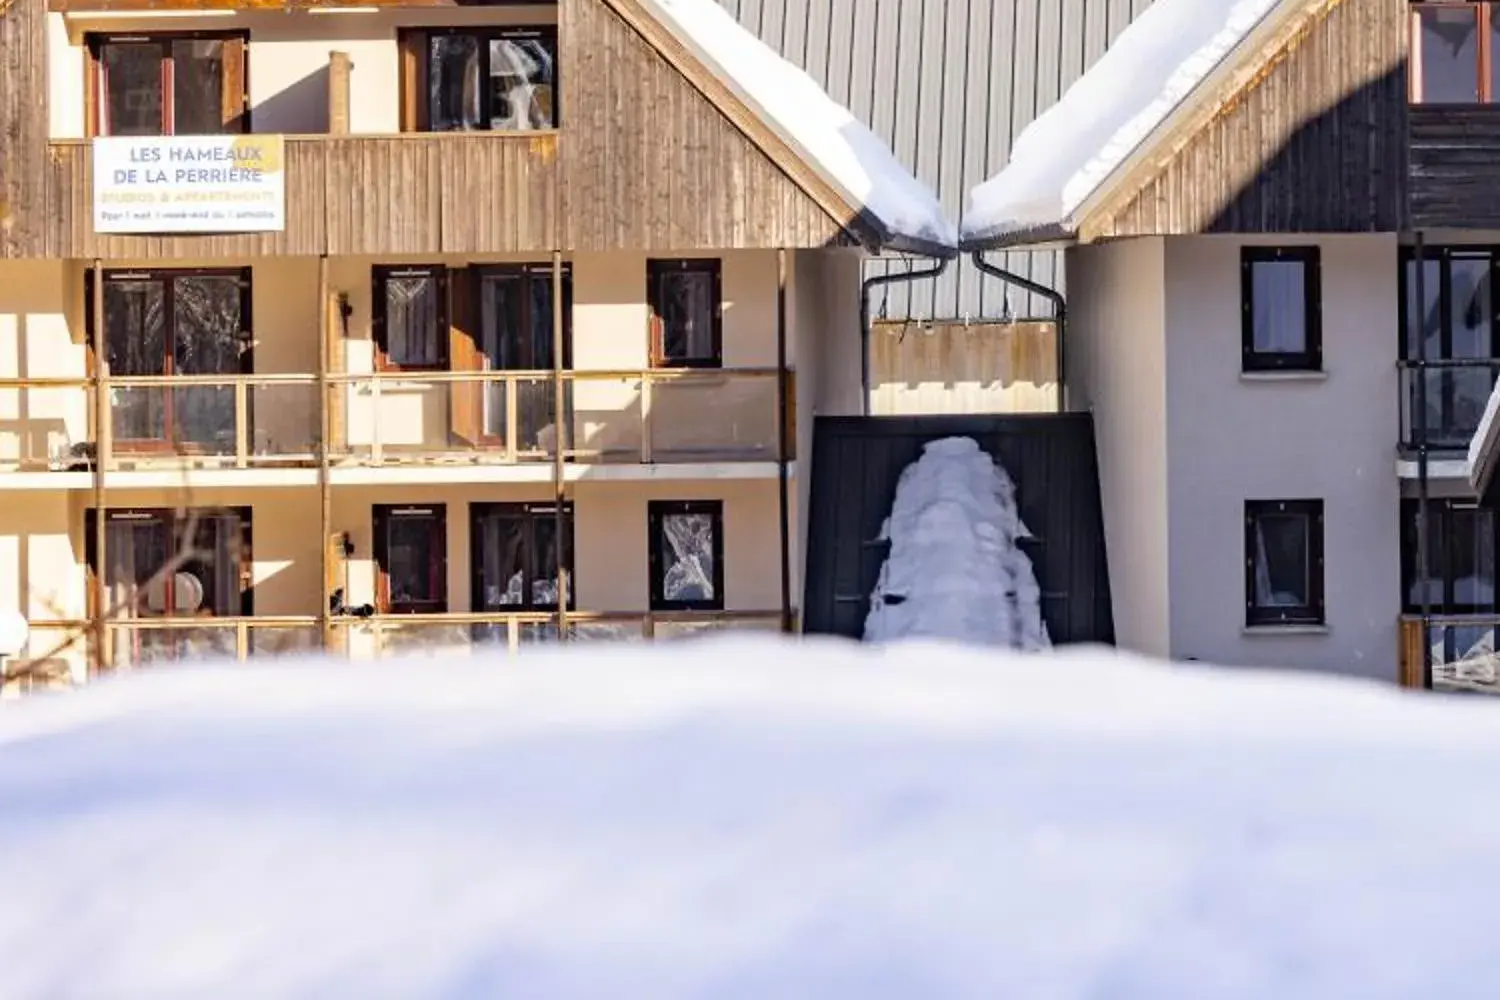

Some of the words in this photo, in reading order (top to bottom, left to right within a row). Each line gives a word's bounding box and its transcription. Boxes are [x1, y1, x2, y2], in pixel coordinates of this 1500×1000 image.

[130, 147, 161, 162] LES
[169, 146, 263, 162] HAMEAUX
[114, 169, 137, 184] DE
[145, 169, 168, 183] LA
